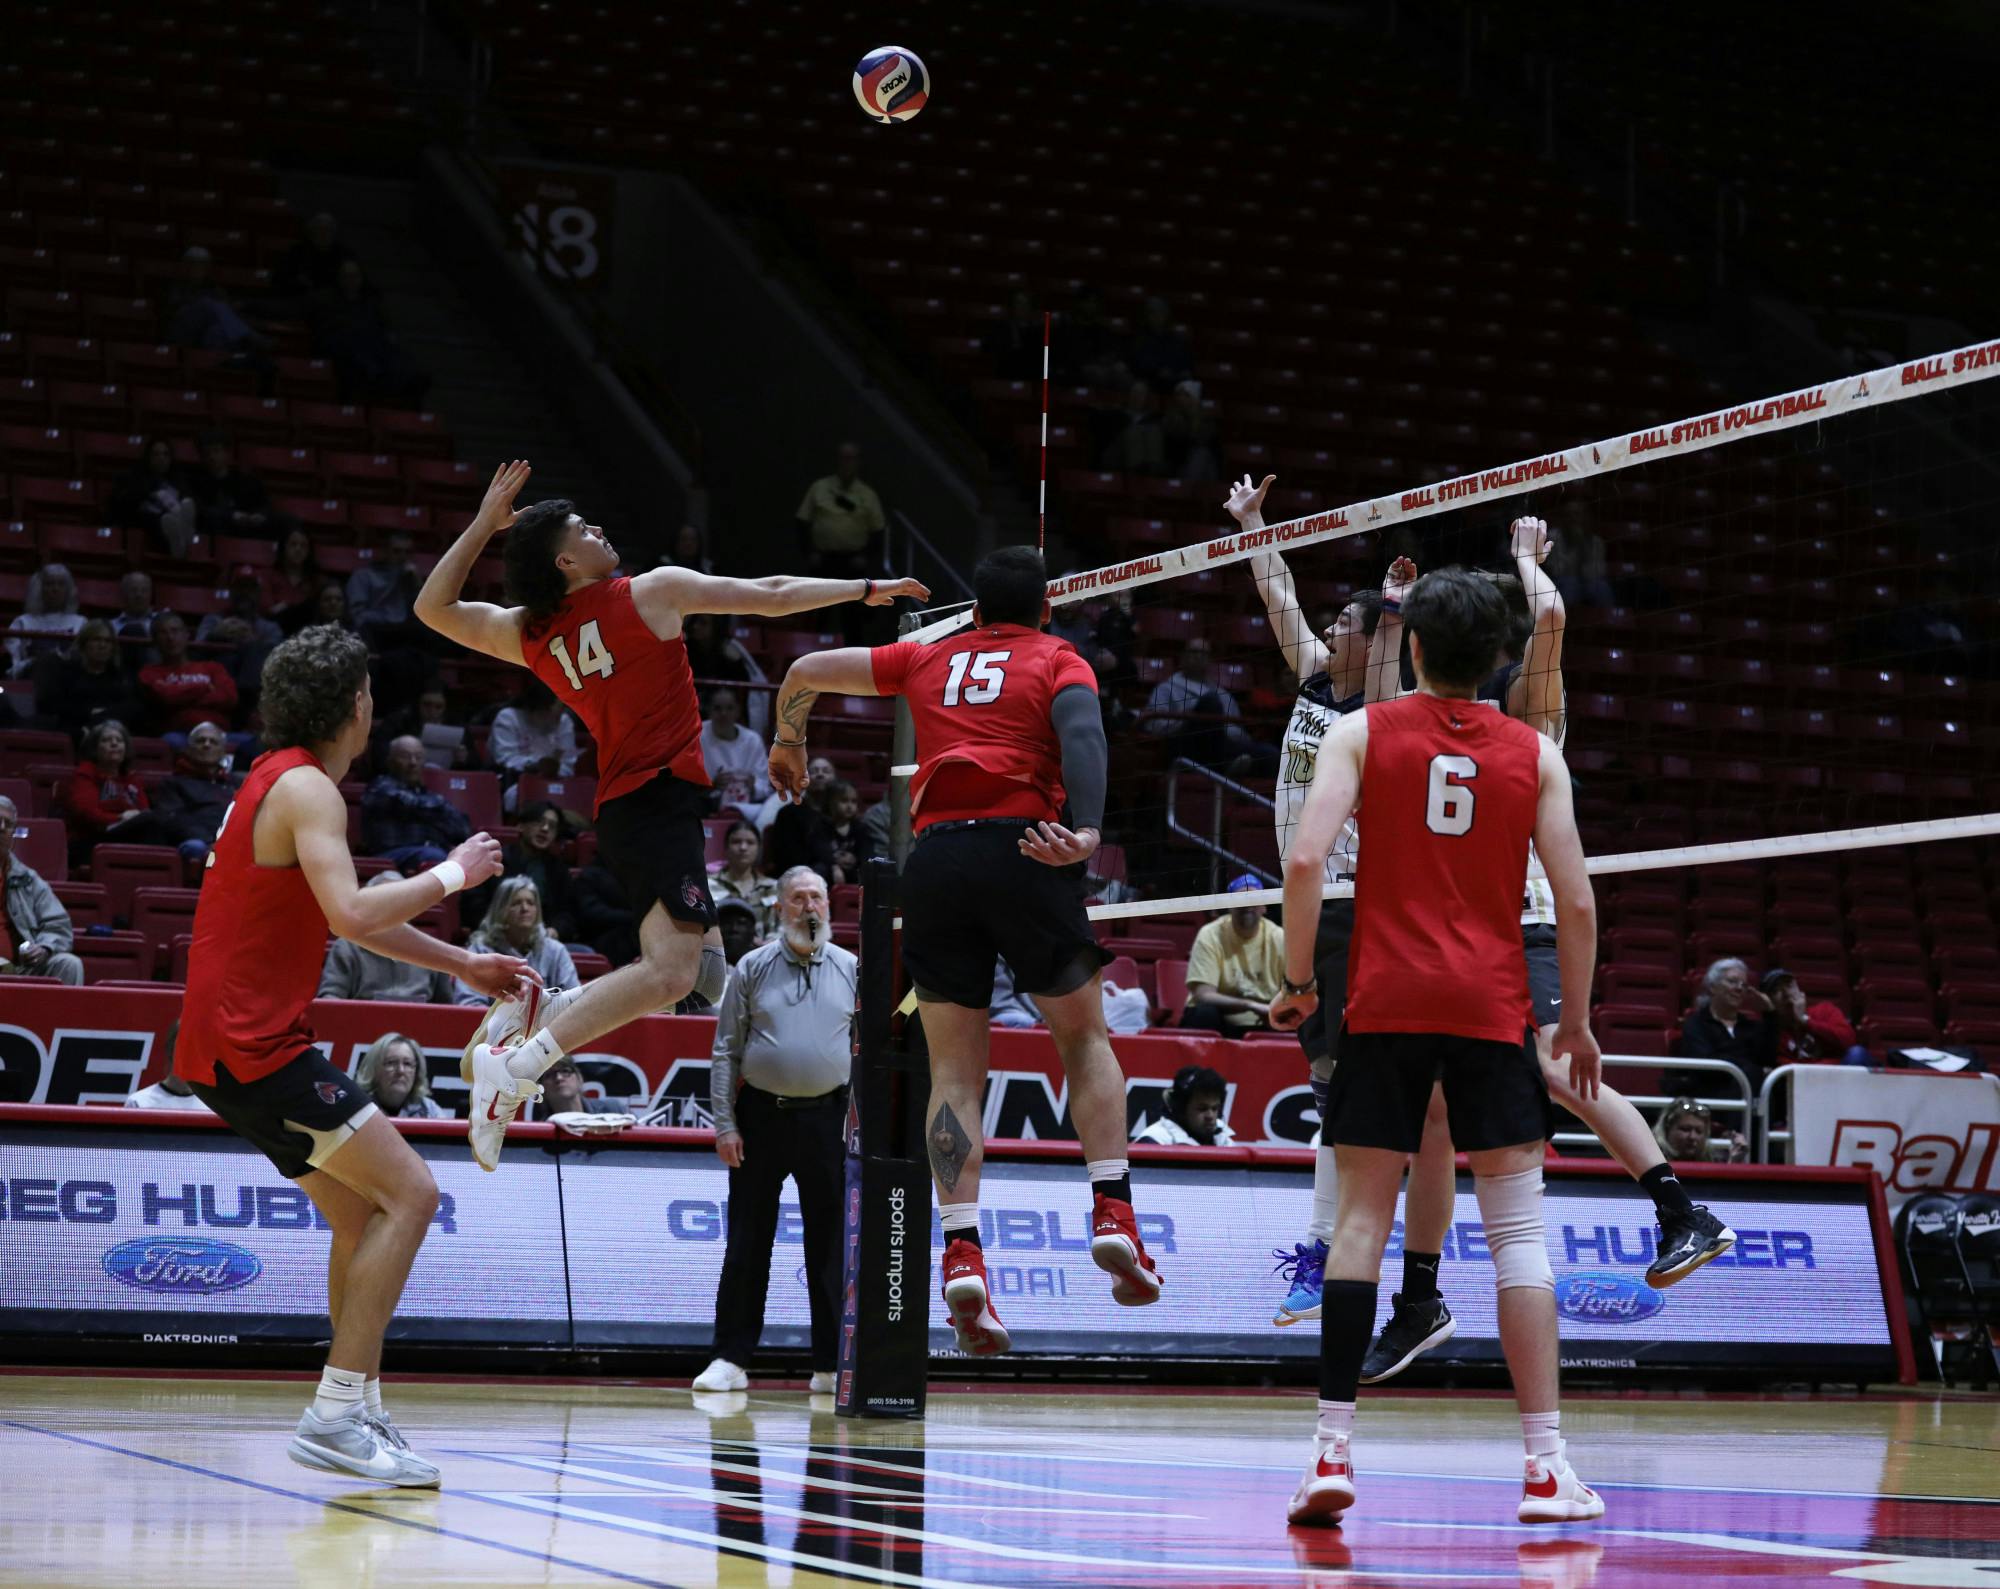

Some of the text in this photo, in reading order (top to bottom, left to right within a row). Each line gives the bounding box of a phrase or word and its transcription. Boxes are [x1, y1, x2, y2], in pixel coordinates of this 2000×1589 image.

[881, 72, 907, 94] NCAA
[1901, 358, 1947, 386] BALL
[1629, 389, 1828, 455] BALL STATE VOLLEYBALL
[1401, 454, 1568, 511] BALL STATE VOLLEYBALL
[1207, 510, 1349, 560] BALL STATE VOLLEYBALL
[1099, 556, 1163, 586] VOLLEYBALL
[547, 617, 615, 691] 14
[942, 650, 1012, 707] 15
[1425, 753, 1479, 836] 6
[0, 1179, 118, 1224] EG
[134, 1246, 230, 1285] Ford
[885, 1187, 906, 1322] sports imports
[1563, 1279, 1640, 1316] Ford
[143, 1333, 238, 1344] DAKTRONICS
[1560, 1358, 1637, 1368] DAKTRONICS
